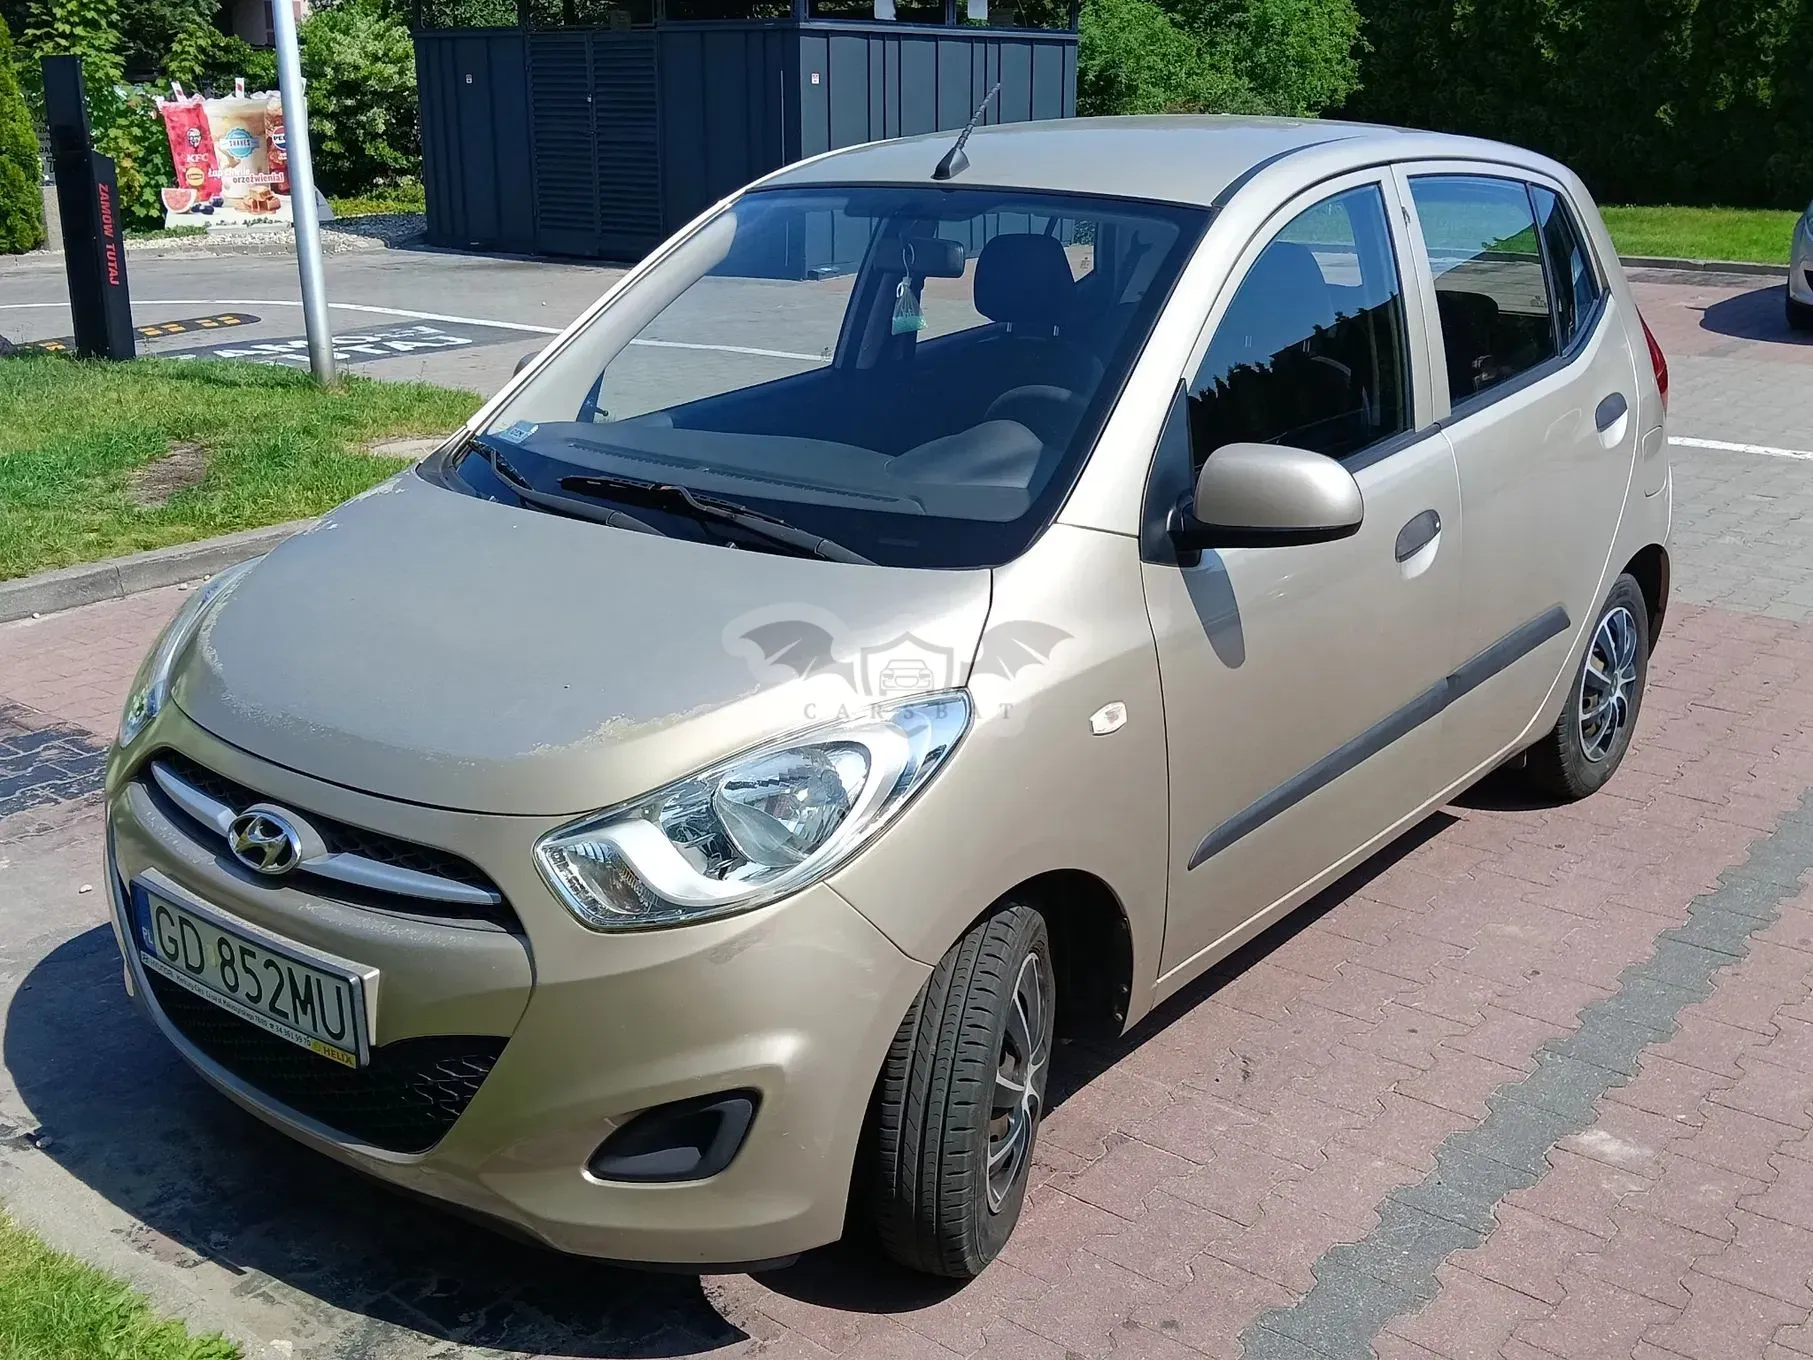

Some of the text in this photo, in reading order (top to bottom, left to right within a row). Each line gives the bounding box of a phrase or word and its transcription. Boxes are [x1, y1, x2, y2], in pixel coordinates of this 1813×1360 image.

[186, 153, 209, 163] KFC
[105, 243, 120, 286] TUTAJ
[142, 926, 154, 945] PL
[155, 905, 205, 975] GD
[217, 936, 346, 1041] 852MU
[323, 1047, 353, 1065] HELIX
